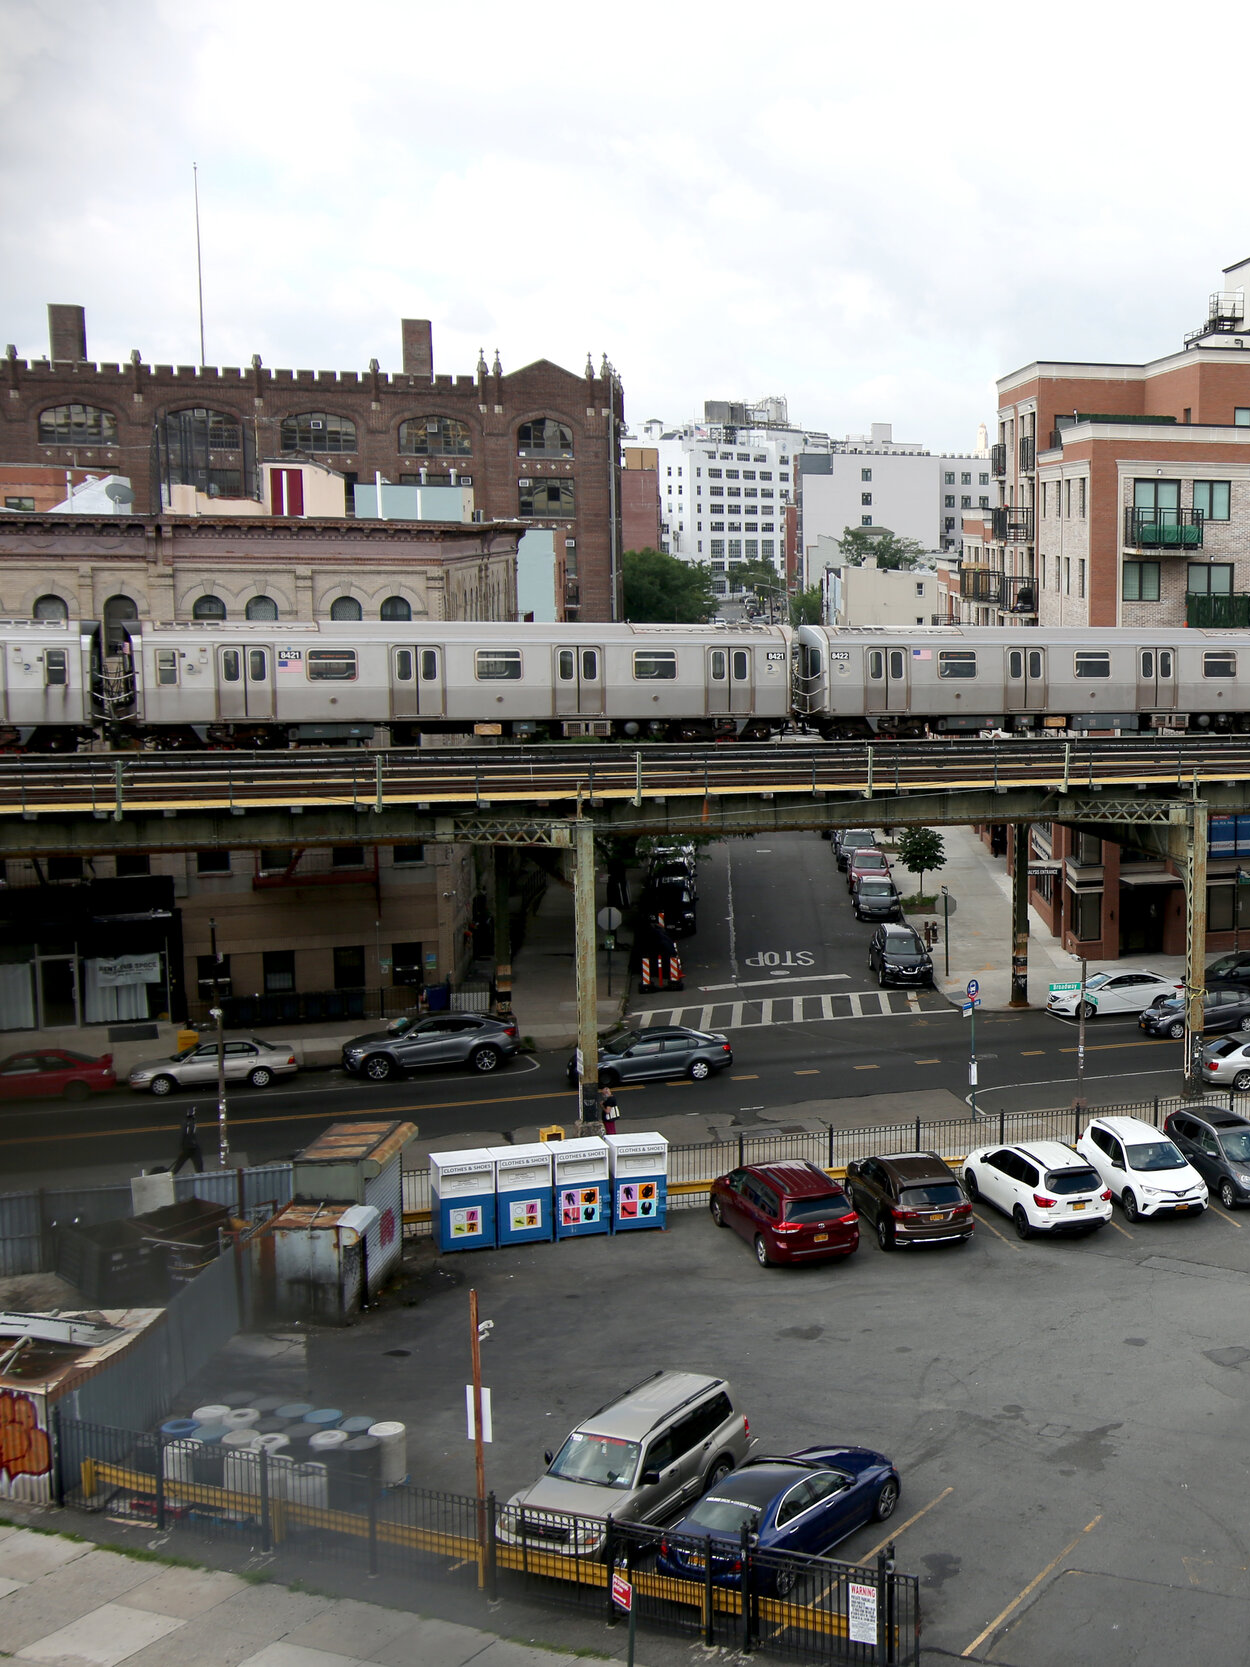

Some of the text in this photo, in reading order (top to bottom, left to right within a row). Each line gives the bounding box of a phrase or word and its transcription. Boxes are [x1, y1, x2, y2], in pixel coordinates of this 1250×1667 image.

[280, 651, 300, 659] 8421
[768, 652, 784, 660] 8421
[831, 652, 849, 660] 8422
[745, 950, 815, 967] STOP
[134, 961, 157, 969] SPACE
[851, 1585, 875, 1598] WARNING
